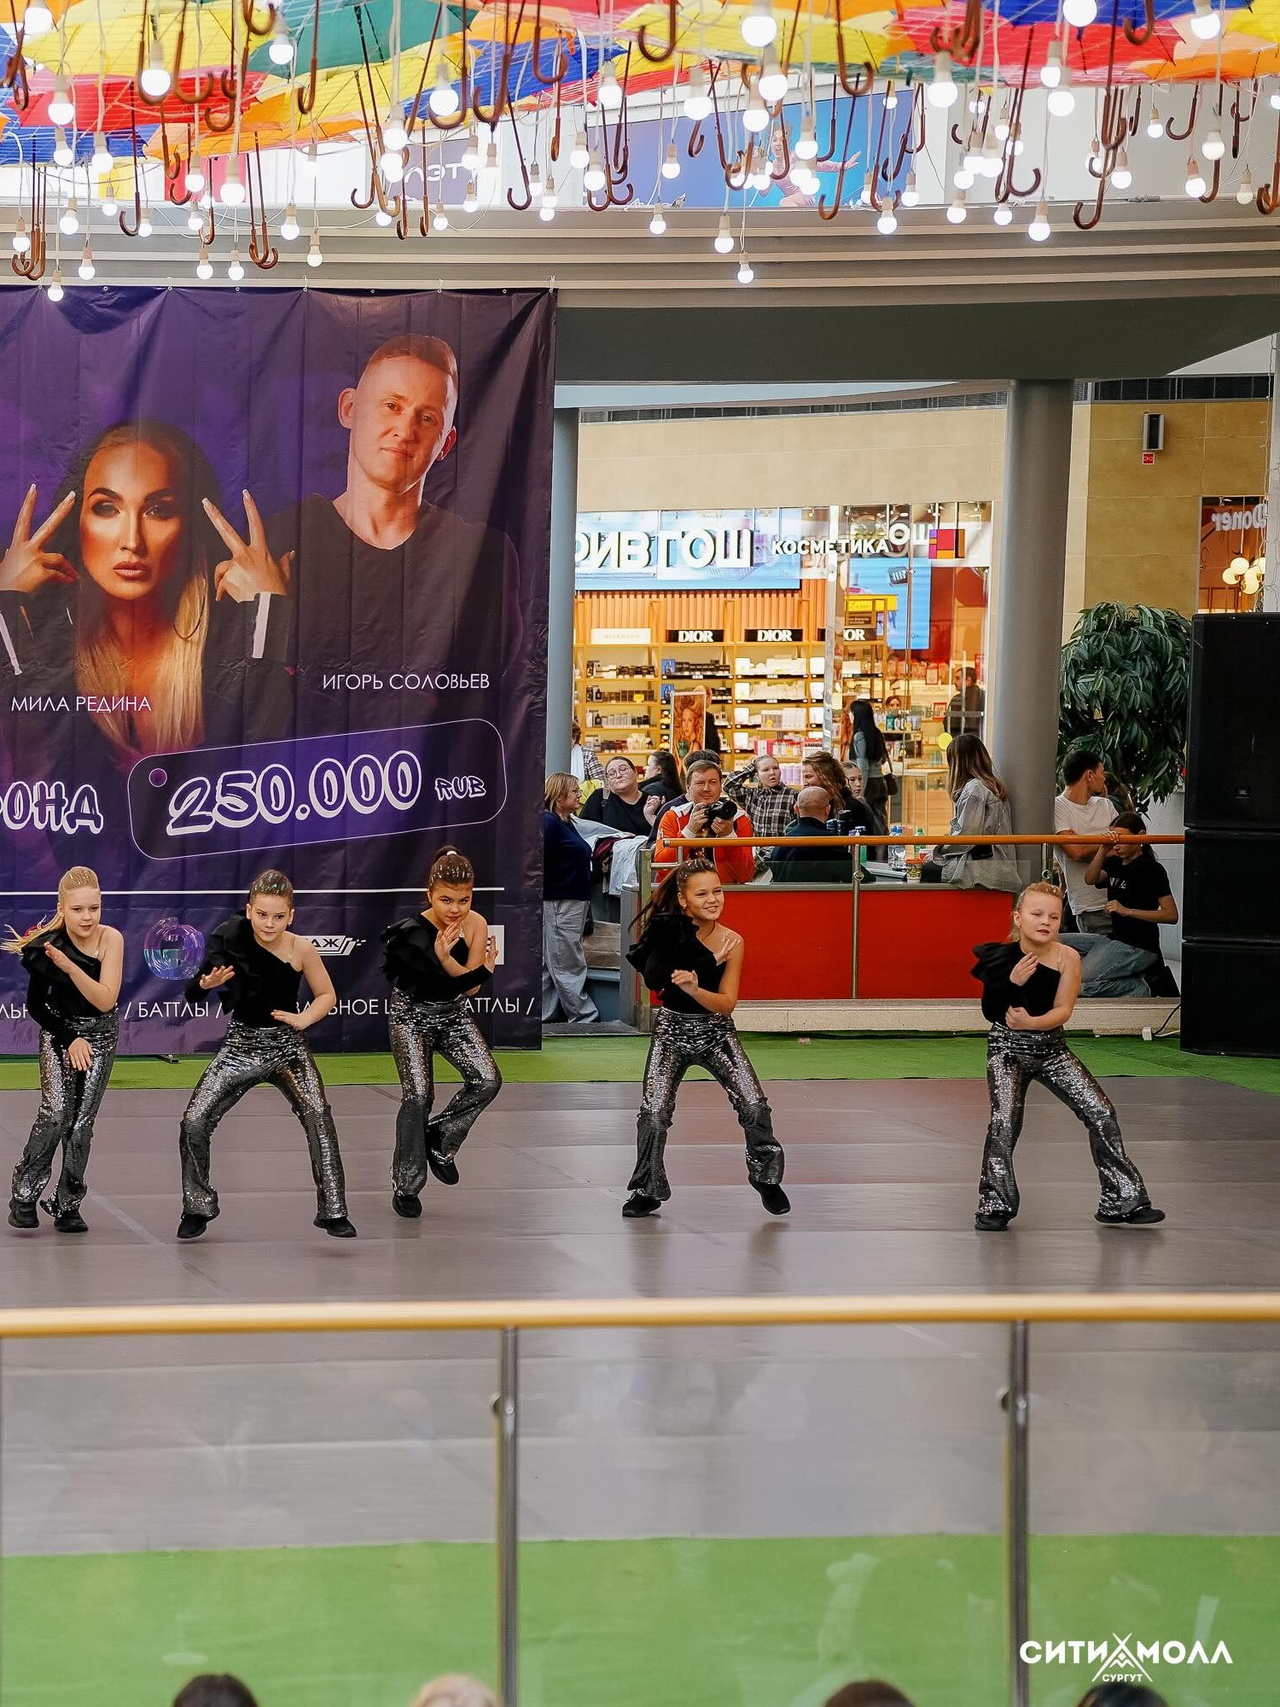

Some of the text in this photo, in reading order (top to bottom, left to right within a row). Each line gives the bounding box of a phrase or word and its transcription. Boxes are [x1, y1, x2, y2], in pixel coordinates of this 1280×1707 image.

[658, 529, 754, 569] ГОШ
[773, 538, 889, 555] КОСМЕТИКА
[678, 630, 714, 643] DIOR
[757, 629, 793, 642] DIOR
[843, 629, 865, 641] OR
[323, 674, 490, 690] ИГОРЬ СОЛОВЬЕВ
[11, 697, 152, 714] МИЛА РЕДИНА
[166, 750, 487, 837] 250.000 RUB
[138, 1001, 209, 1018] БАТТЛЫ
[464, 997, 520, 1013] АТТЛЫ
